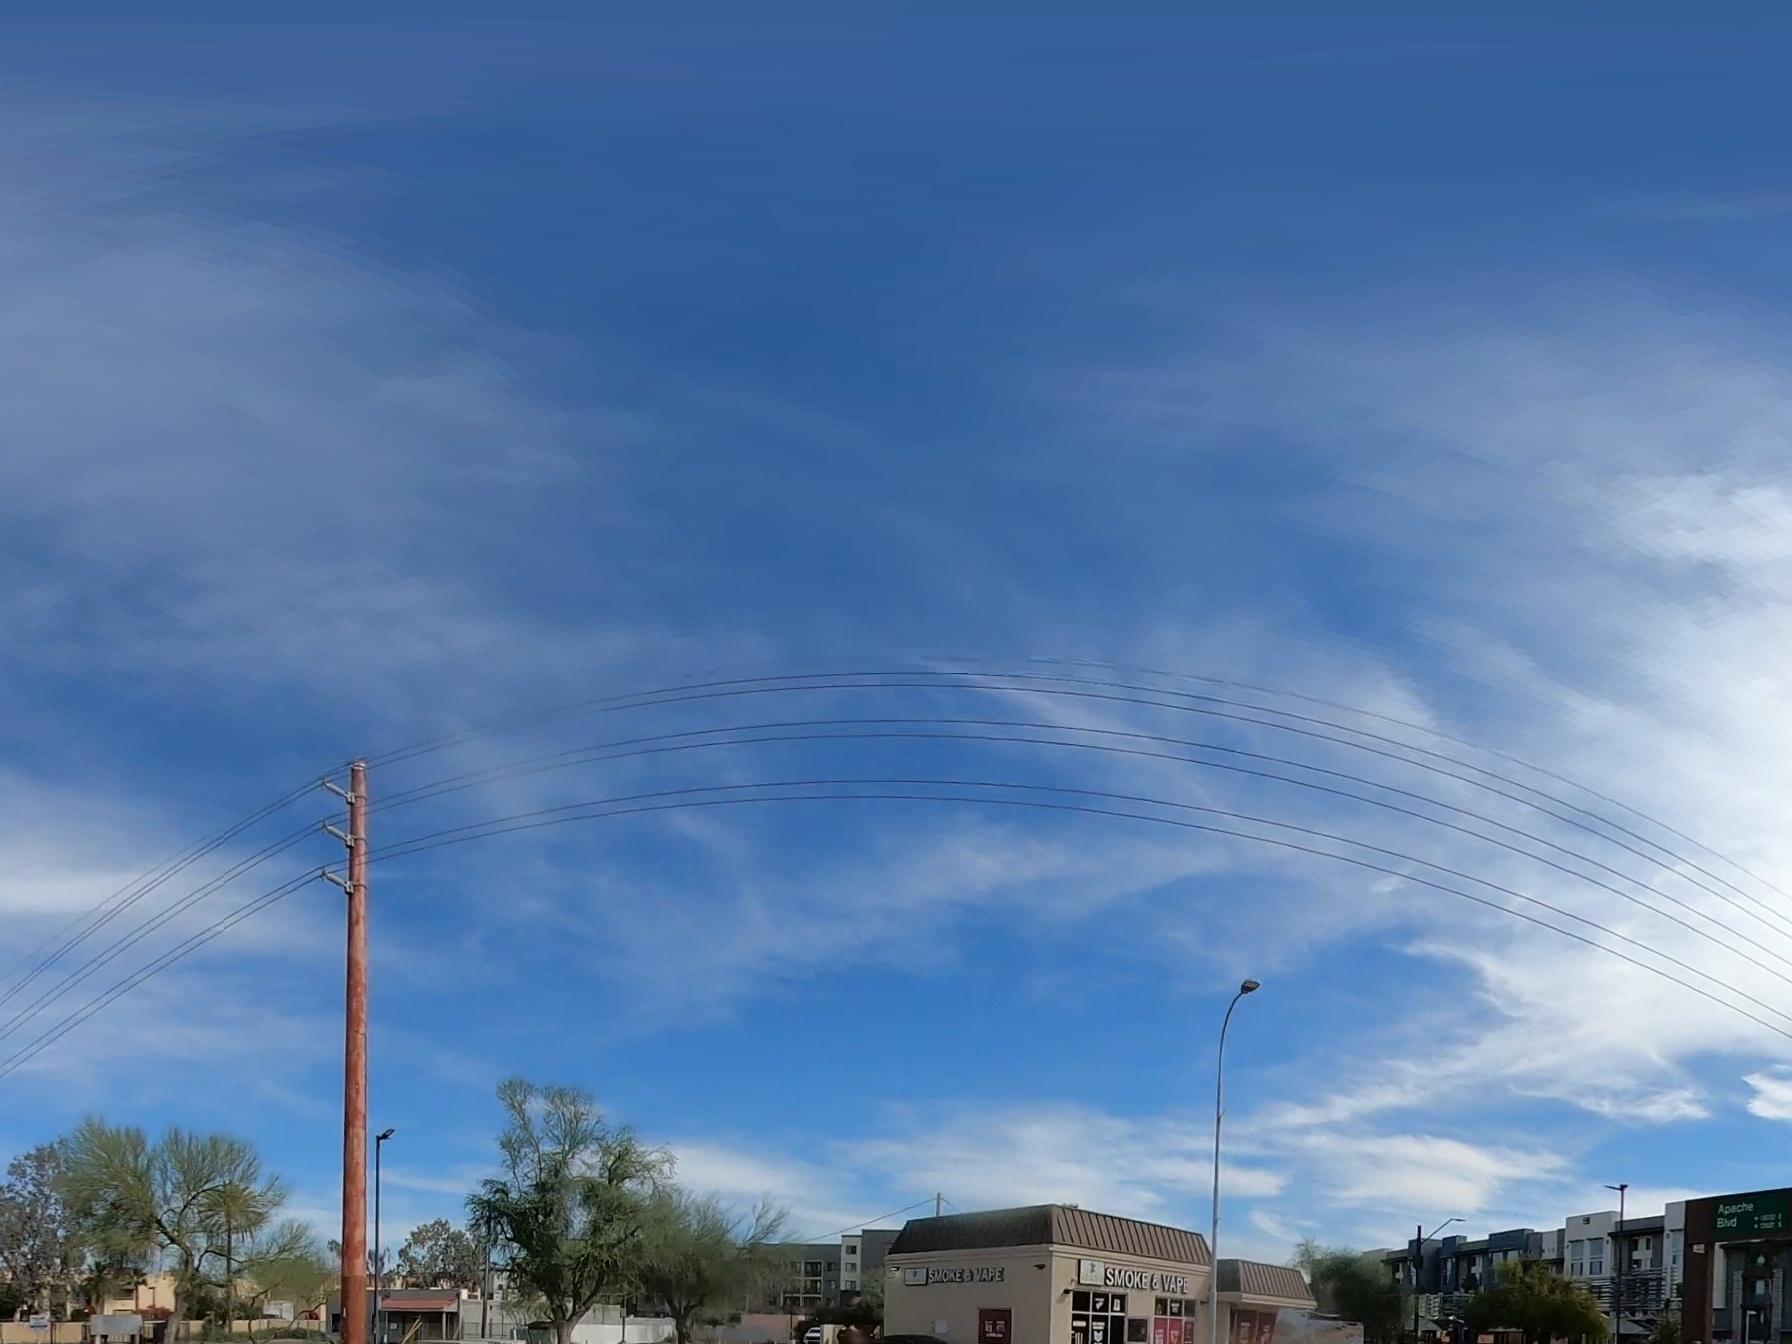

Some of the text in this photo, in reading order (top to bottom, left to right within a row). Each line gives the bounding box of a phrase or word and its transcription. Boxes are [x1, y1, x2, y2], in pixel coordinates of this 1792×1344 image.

[1718, 1202, 1754, 1215] Apache
[1716, 1216, 1738, 1228] Blvd
[928, 1268, 964, 1283] SMOKE
[976, 1267, 1005, 1282] VAPE
[1106, 1267, 1149, 1289] SMOKE
[1150, 1274, 1160, 1290] &
[1161, 1274, 1189, 1294] VAPE
